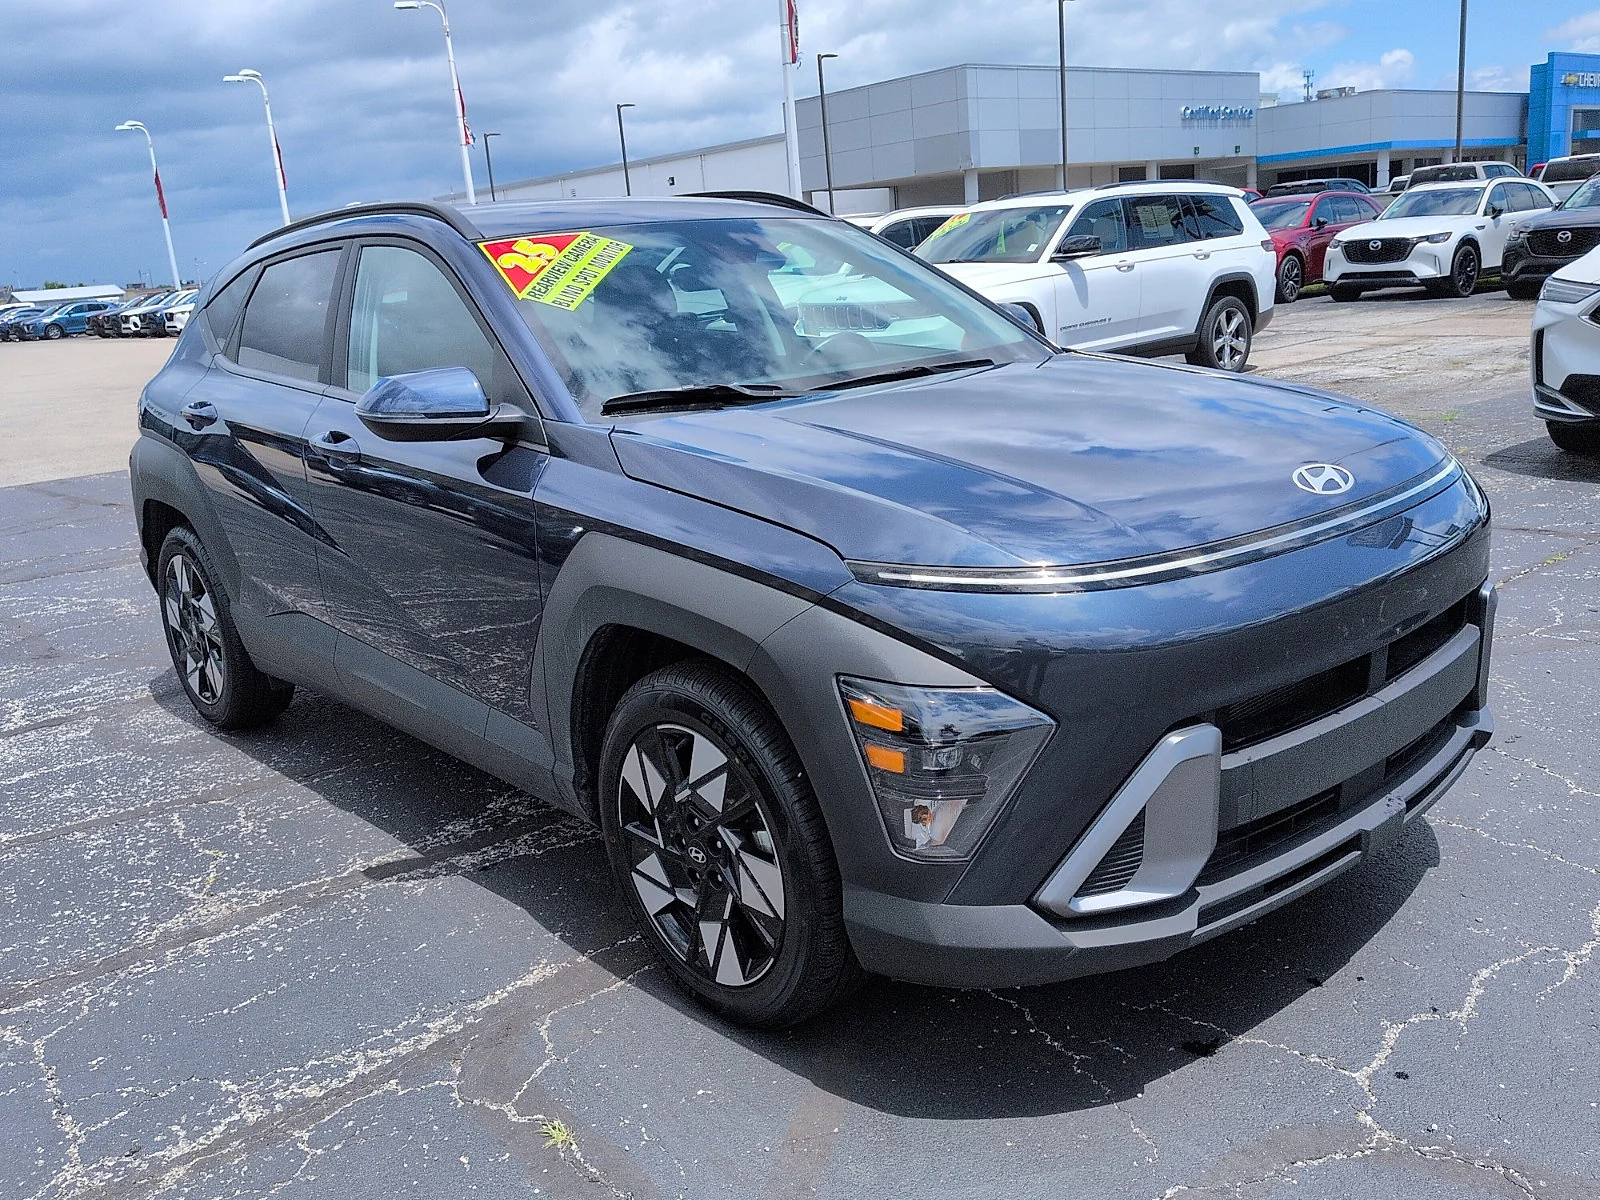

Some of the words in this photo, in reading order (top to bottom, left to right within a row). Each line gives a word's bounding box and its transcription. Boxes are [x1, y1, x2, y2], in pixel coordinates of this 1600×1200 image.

[1182, 105, 1220, 121] Certified
[1221, 105, 1254, 121] Service
[497, 239, 560, 274] 25
[526, 259, 573, 301] REARVIEW
[563, 235, 600, 264] CAMERA
[552, 284, 586, 308] BLIND
[571, 268, 601, 286] SPOT
[588, 241, 627, 270] MONITOR
